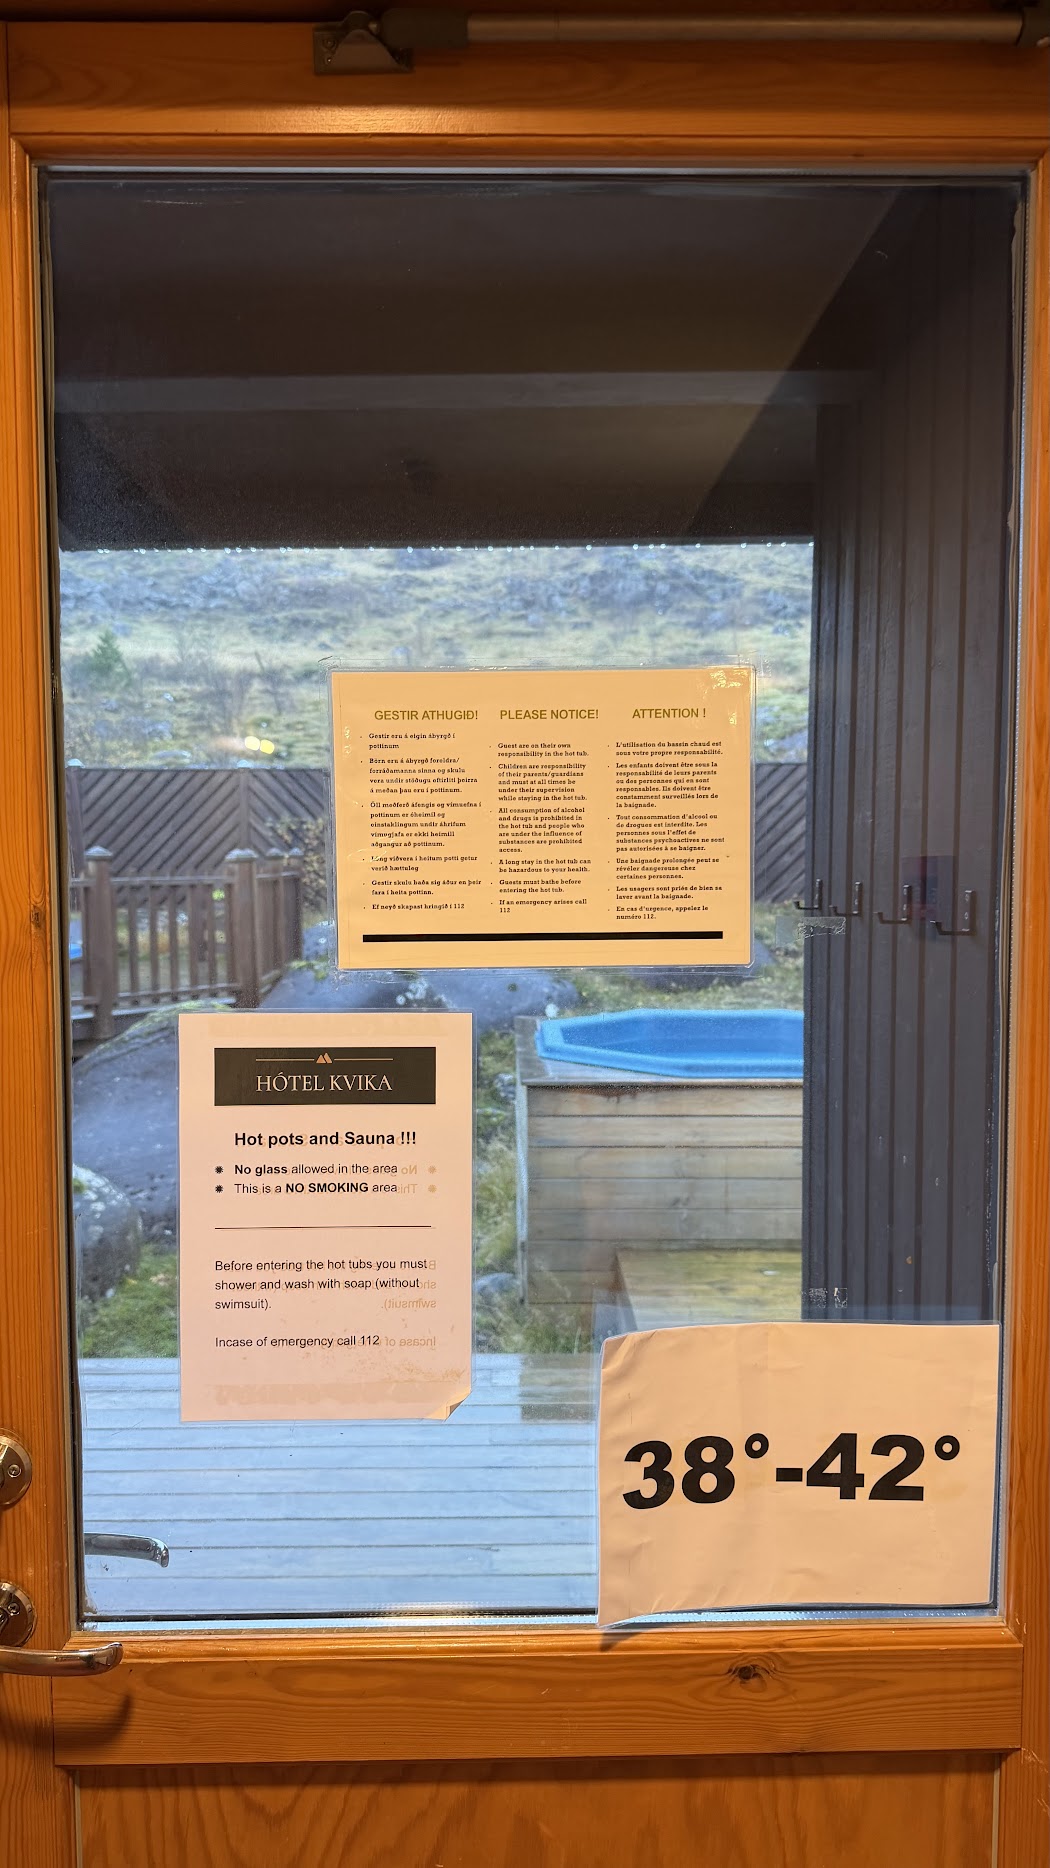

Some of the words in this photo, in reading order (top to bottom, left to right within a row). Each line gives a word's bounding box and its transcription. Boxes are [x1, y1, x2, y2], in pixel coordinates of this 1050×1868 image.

[374, 711, 419, 720] GESTIR
[422, 710, 478, 720] ATHUGIÐ!
[500, 710, 547, 720] PLEASE
[551, 710, 599, 720] NOTICE!
[632, 708, 699, 719] ATTENTION
[256, 1072, 324, 1092] HÓTEL
[330, 1074, 393, 1091] KVIKA
[235, 1133, 263, 1145] Hot
[269, 1133, 304, 1148] pots
[310, 1132, 339, 1144] and
[345, 1132, 395, 1144] Sauna
[402, 1132, 416, 1144] !!!
[235, 1165, 252, 1174] No
[255, 1165, 288, 1176] glass
[292, 1164, 334, 1174] allowed
[339, 1164, 348, 1173] in
[352, 1164, 369, 1173] the
[234, 1184, 258, 1193] This
[263, 1184, 271, 1193] is
[286, 1183, 304, 1193] NO
[309, 1183, 368, 1193] SMOKING
[216, 1261, 253, 1270] Before
[256, 1260, 302, 1272] entering
[306, 1260, 324, 1269] the
[328, 1260, 345, 1269] hot
[348, 1259, 373, 1269] tubs
[376, 1261, 396, 1271] you
[215, 1280, 257, 1290] shower
[260, 1280, 281, 1289] and
[284, 1279, 314, 1288] wash
[318, 1279, 340, 1288] with
[344, 1281, 372, 1290] soap
[376, 1278, 420, 1290] (without
[215, 1299, 271, 1311] swimsuit).
[216, 1338, 253, 1347] Incase
[256, 1337, 268, 1346] of
[270, 1338, 334, 1348] emergency
[337, 1336, 356, 1346] call
[361, 1335, 380, 1345] 112
[622, 1432, 960, 1510] 38°-42°
